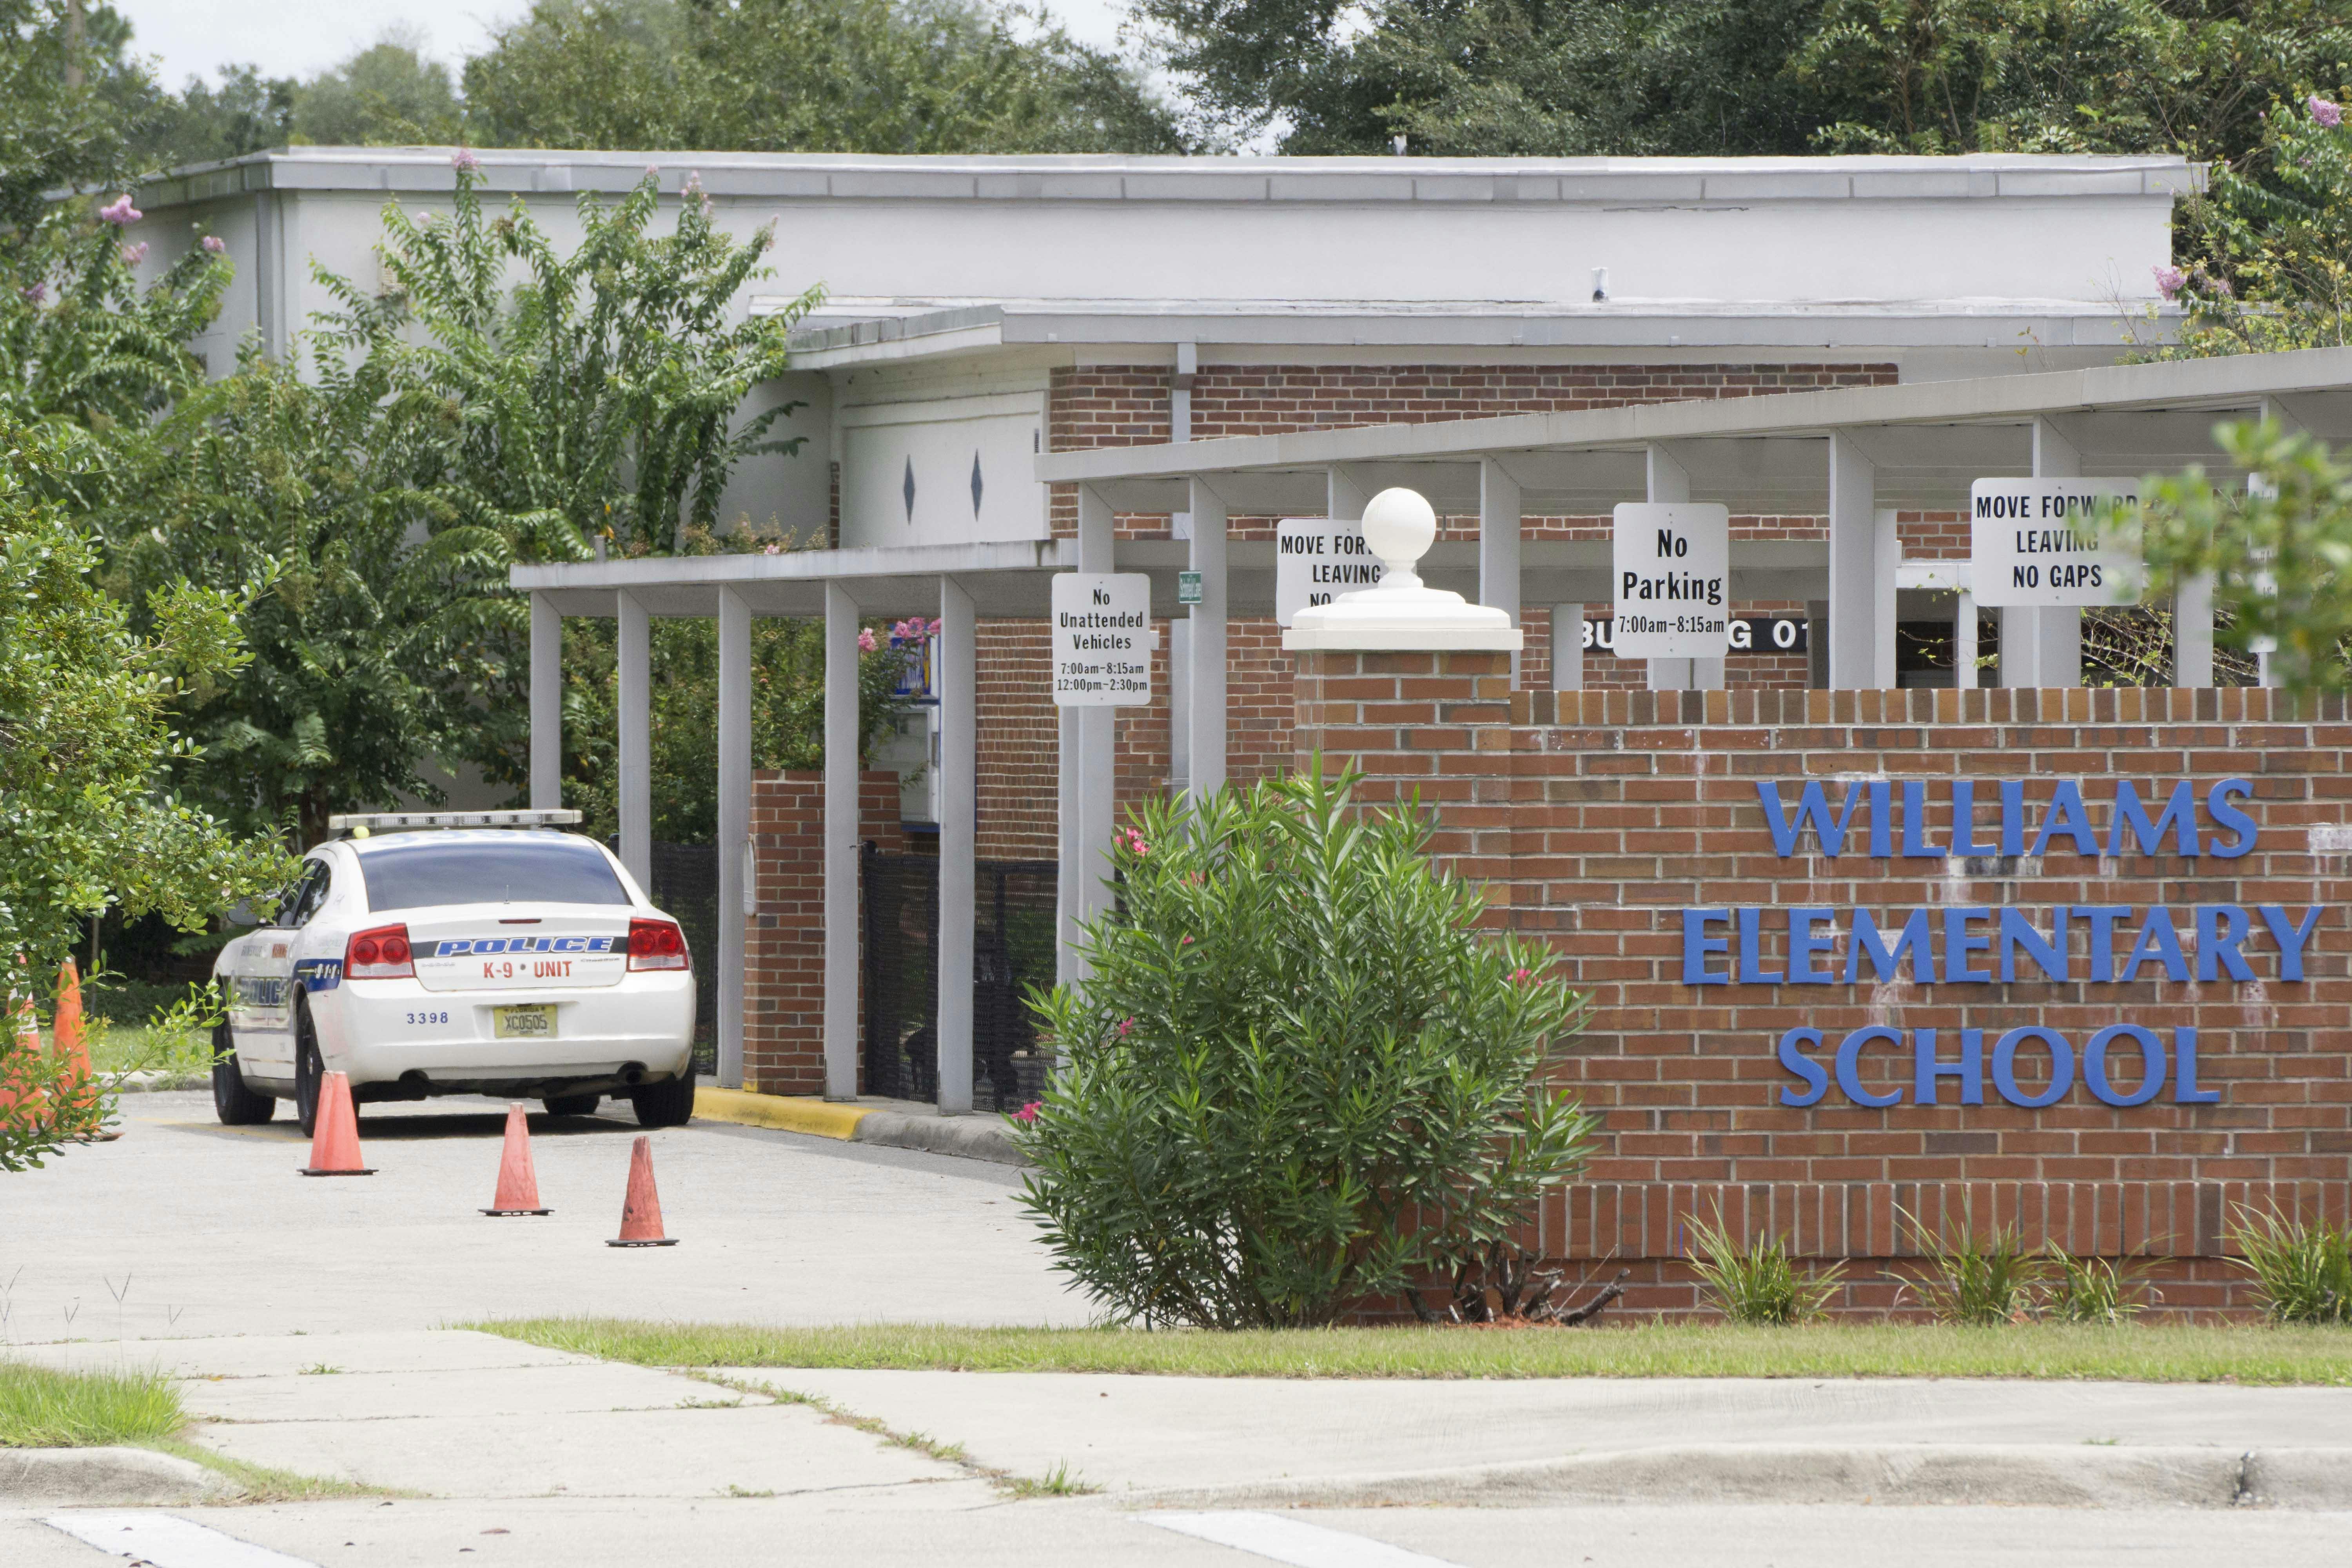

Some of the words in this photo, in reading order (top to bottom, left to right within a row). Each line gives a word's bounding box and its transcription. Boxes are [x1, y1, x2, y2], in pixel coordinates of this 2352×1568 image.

[1976, 496, 2030, 518] MOVE
[2042, 495, 2138, 518] FORWRD
[1281, 535, 1324, 554] MOVE
[1657, 529, 1687, 557] No
[2016, 530, 2098, 553] LEAVING
[1312, 564, 1381, 583] LEAVING
[2013, 565, 2038, 588] NO
[2050, 564, 2102, 588] GAPS
[1093, 589, 1110, 605] No
[1623, 571, 1722, 605] Parking
[1060, 612, 1143, 628] Unattended
[1619, 616, 1724, 633] 7:00am-8:15am
[1073, 634, 1131, 650] Vehicles
[1061, 662, 1144, 675] 7:00am-8:15am
[1057, 679, 1147, 692] 12:00pm-2:30pm
[1756, 779, 2258, 858] WILLIAMS
[434, 936, 615, 957] POLICE
[1682, 905, 2324, 984] ELEMENTARY
[483, 962, 513, 978] K-9
[534, 960, 572, 978] UNIT
[407, 1012, 448, 1024] 3398
[1778, 1023, 2221, 1108] SCHOOL
